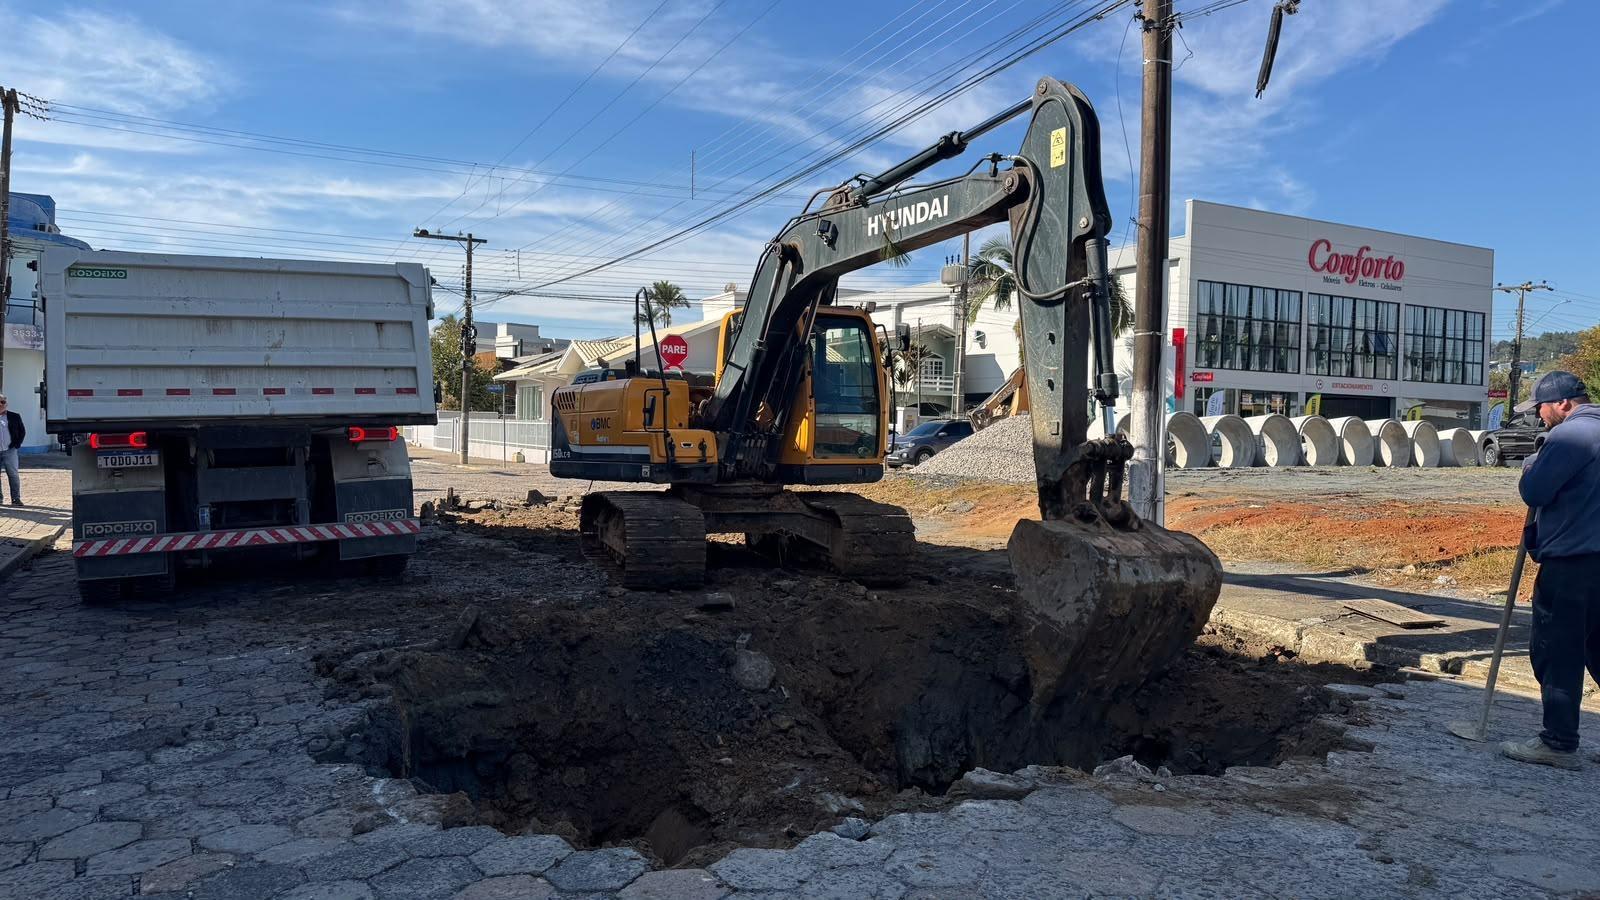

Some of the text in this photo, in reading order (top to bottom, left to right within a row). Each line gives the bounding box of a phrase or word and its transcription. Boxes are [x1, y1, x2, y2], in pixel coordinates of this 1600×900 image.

[867, 195, 949, 237] HYUNDAI
[1308, 239, 1405, 284] Conforto
[662, 344, 687, 355] PARE
[596, 418, 611, 429] BMC
[86, 522, 153, 535] RODOEIXO
